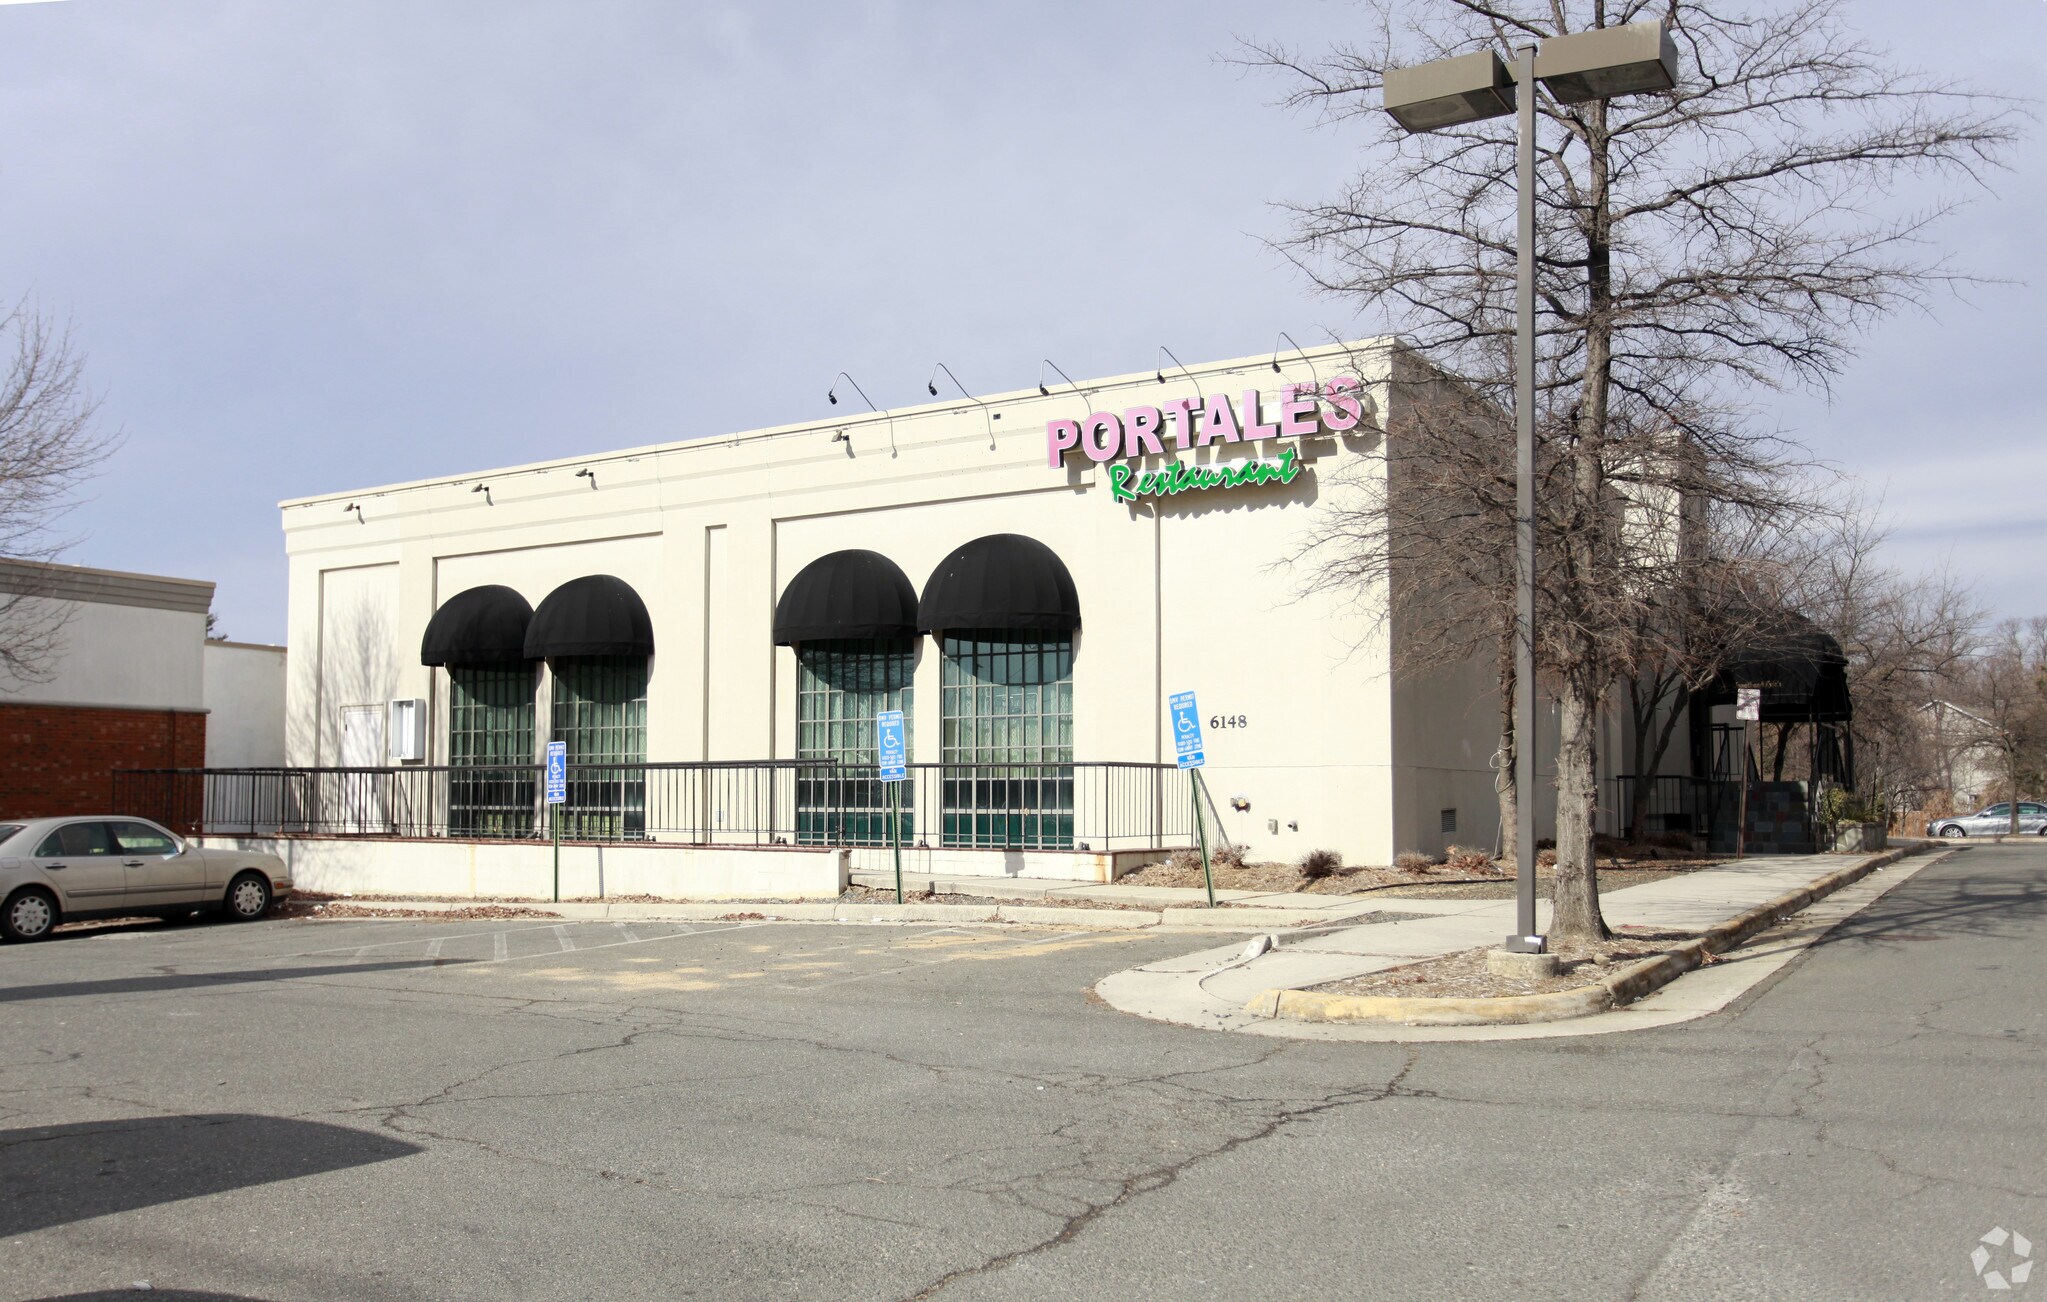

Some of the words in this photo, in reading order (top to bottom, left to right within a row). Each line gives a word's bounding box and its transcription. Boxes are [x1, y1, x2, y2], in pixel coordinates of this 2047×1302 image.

[1045, 376, 1365, 469] PORTALES
[1109, 447, 1299, 503] Restaurant
[1210, 714, 1247, 729] 6148
